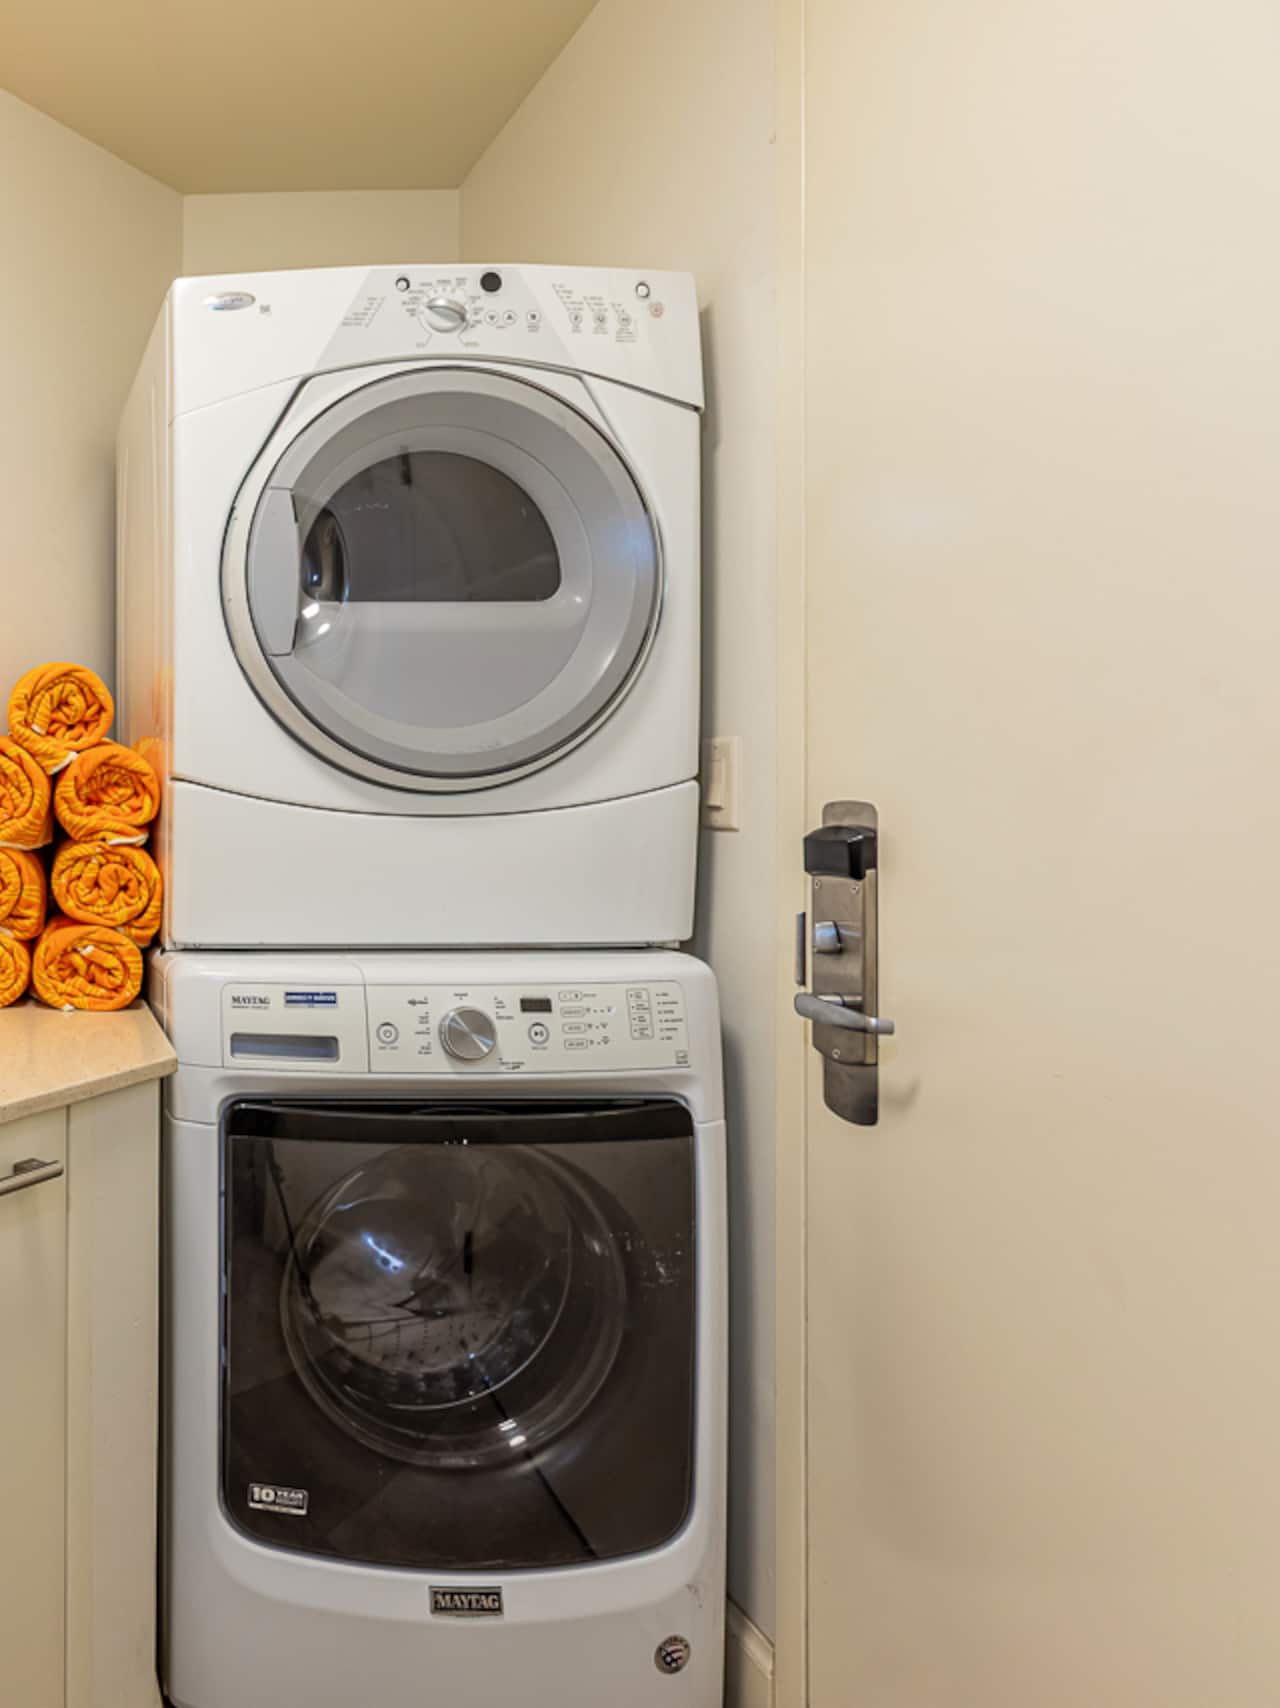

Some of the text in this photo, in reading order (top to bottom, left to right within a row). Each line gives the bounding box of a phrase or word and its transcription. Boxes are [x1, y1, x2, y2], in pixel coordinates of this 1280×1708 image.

[231, 995, 271, 1005] MAYTAG
[253, 1487, 275, 1502] 10
[434, 1594, 499, 1609] MAYTAG
